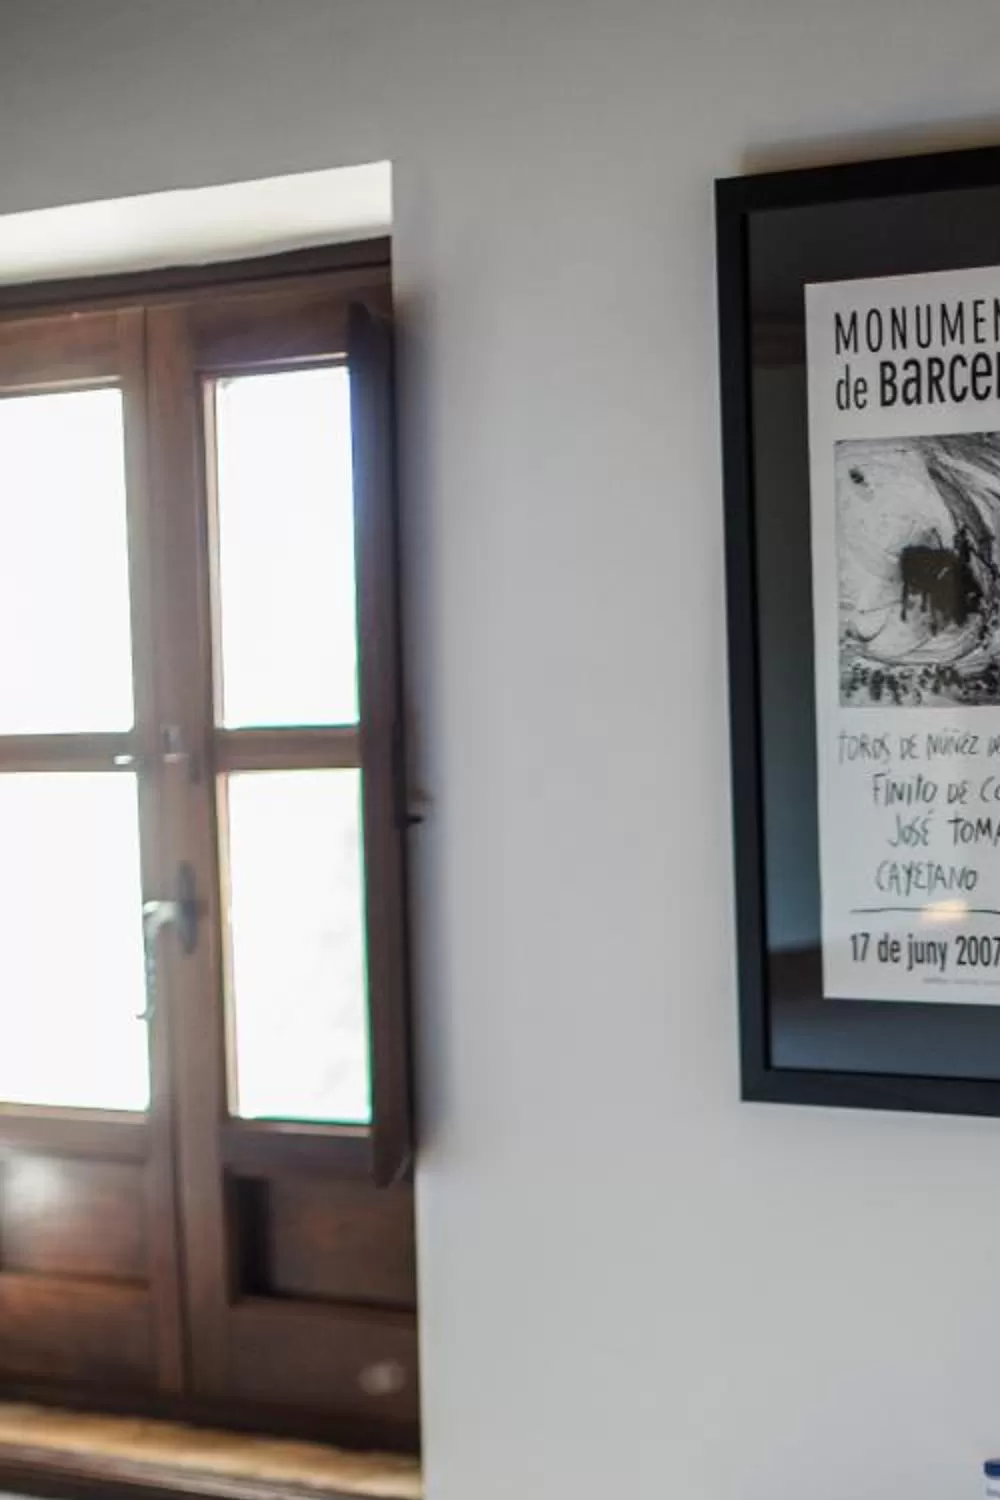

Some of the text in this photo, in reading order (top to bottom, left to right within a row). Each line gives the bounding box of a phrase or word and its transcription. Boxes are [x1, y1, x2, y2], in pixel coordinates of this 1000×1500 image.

[835, 364, 868, 411] de
[899, 732, 920, 761] DE
[946, 779, 968, 805] DE
[875, 859, 979, 897] CAYETANO
[850, 931, 870, 962] 17
[877, 932, 901, 963] de
[906, 932, 948, 972] juny
